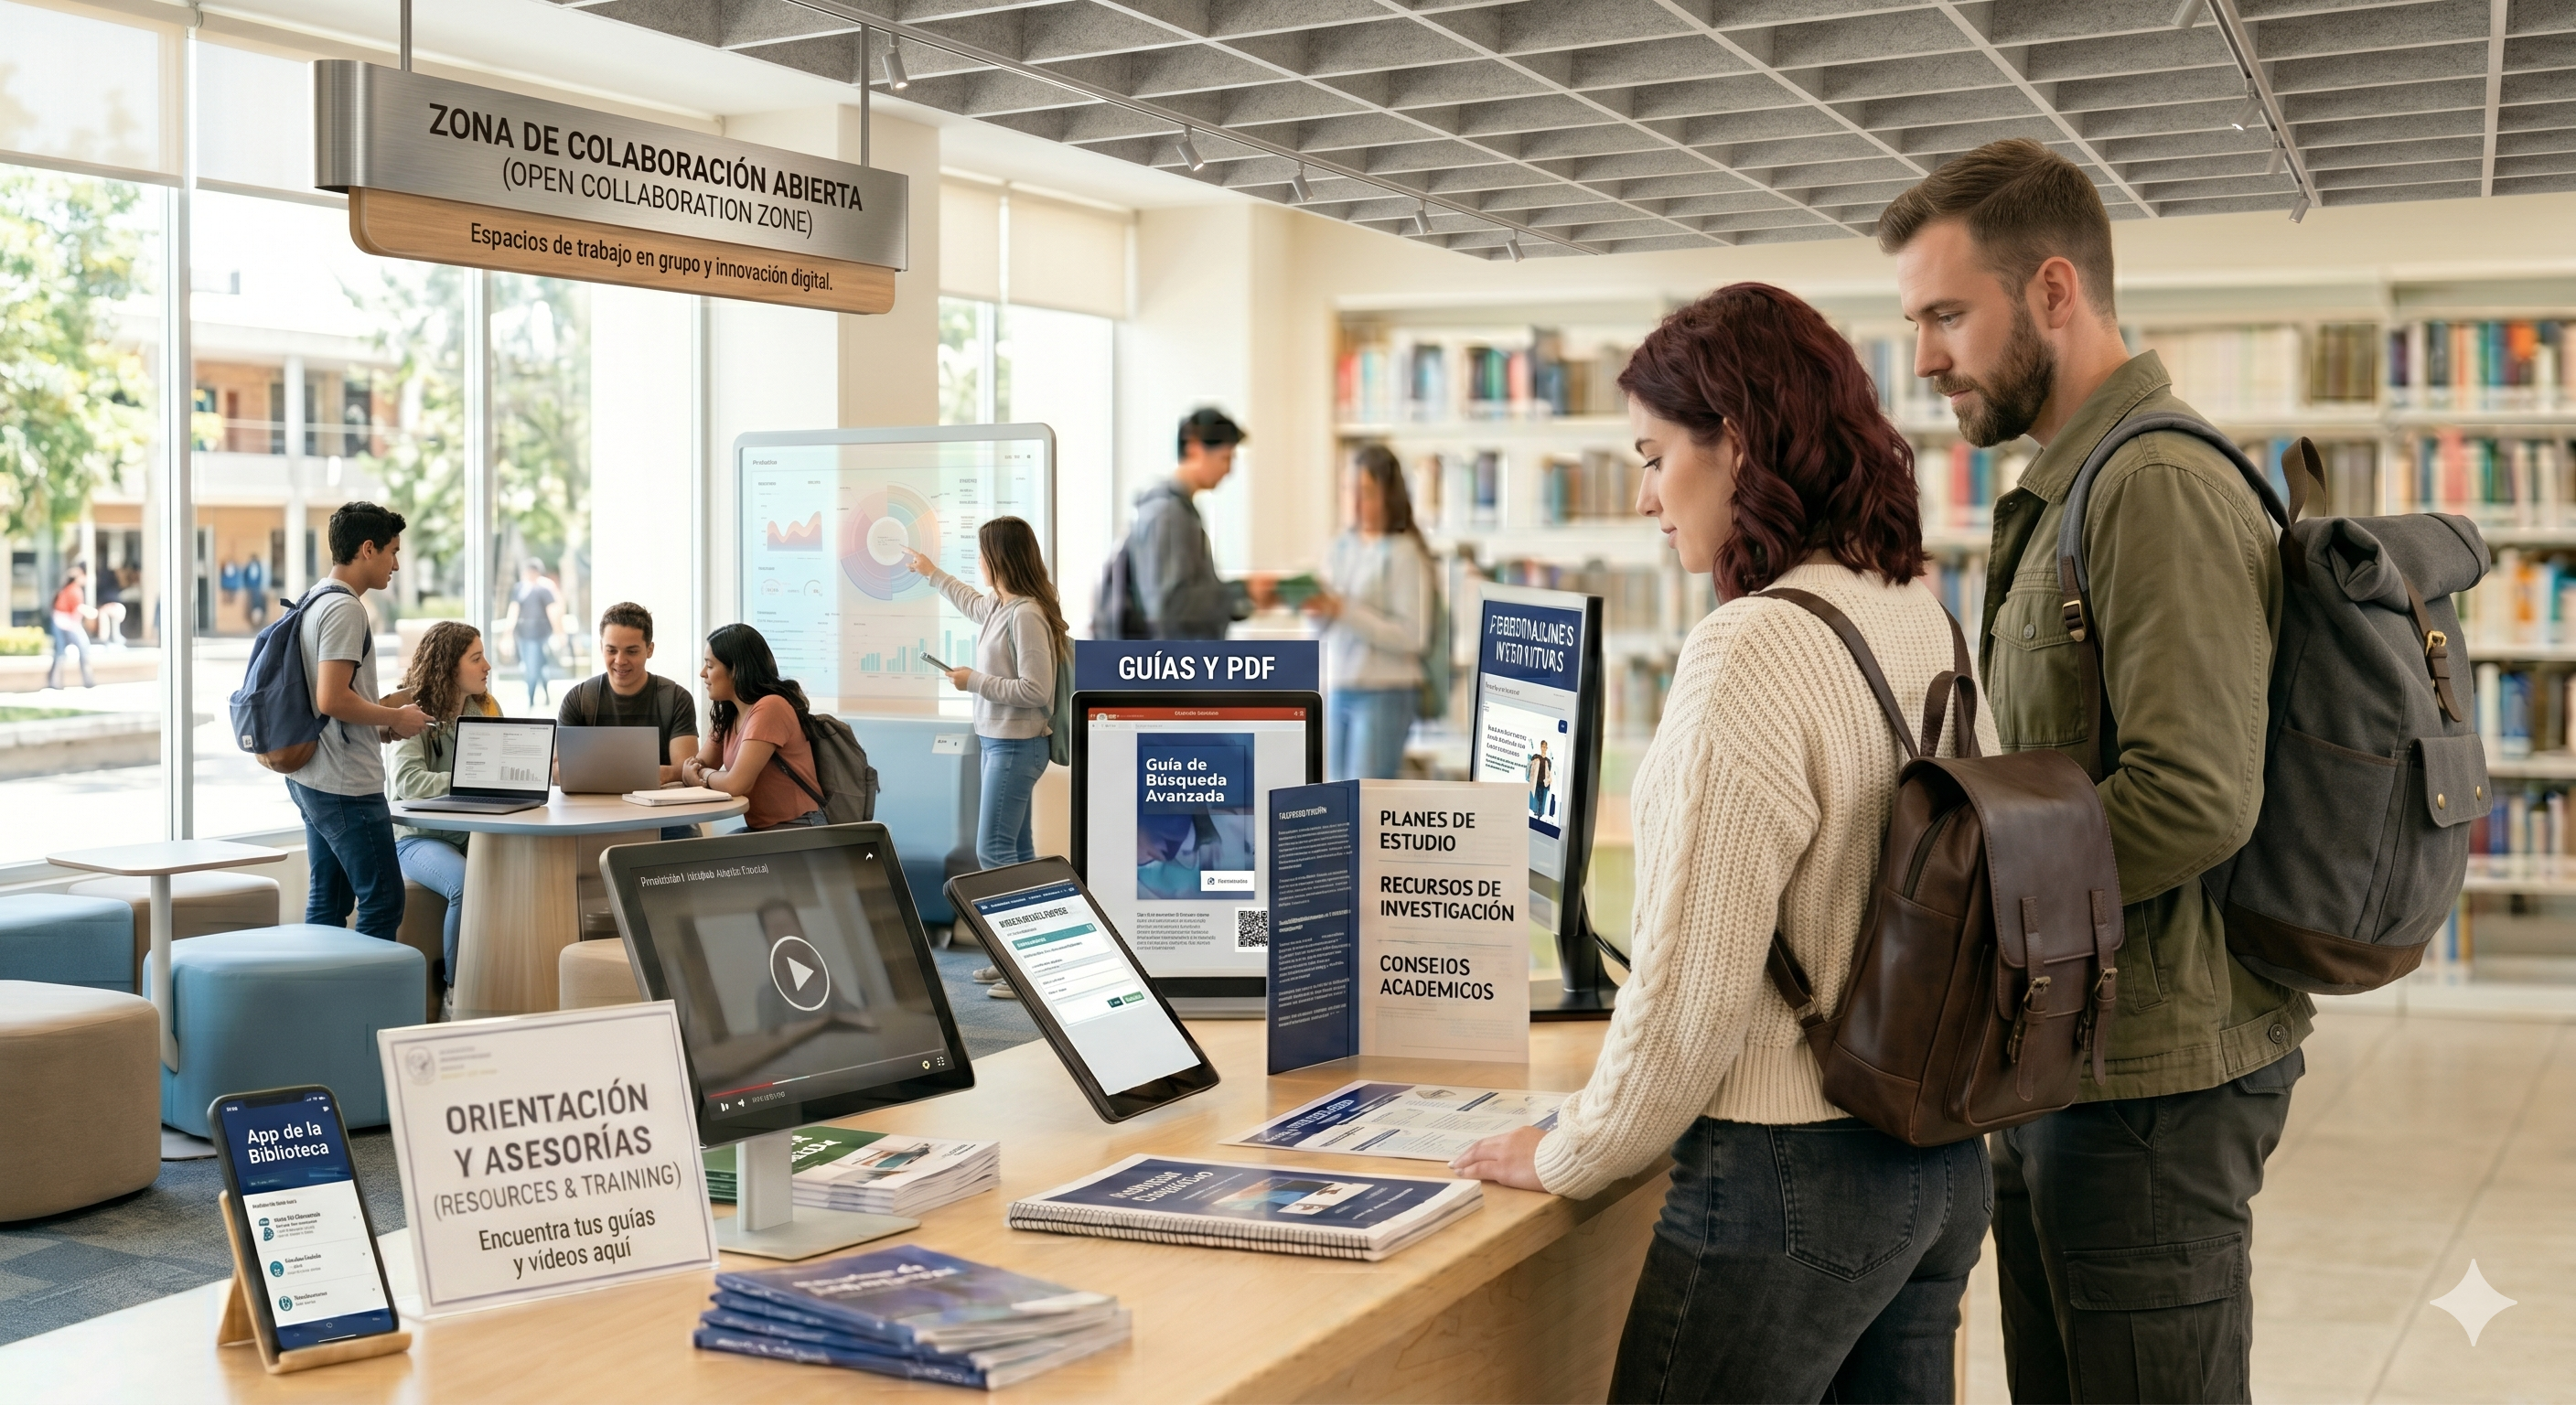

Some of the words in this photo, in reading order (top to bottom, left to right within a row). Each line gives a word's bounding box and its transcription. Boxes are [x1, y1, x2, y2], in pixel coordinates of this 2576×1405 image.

[429, 103, 513, 147] ZONA
[523, 122, 559, 156] DE
[568, 131, 766, 194] COLABORACIÓN
[773, 173, 863, 211] ABIERTA
[503, 157, 574, 196] (OPEN
[581, 174, 751, 223] COLLABORATION
[757, 204, 813, 239] ZONE)
[471, 223, 548, 252] Espacios
[553, 234, 573, 255] de
[577, 238, 632, 267] trabajo
[637, 250, 654, 265] en
[659, 252, 700, 275] grupo
[704, 261, 712, 278] y
[716, 258, 787, 285] innovación
[791, 268, 832, 292] digital.
[1119, 651, 1196, 680] GUÍAS
[1203, 657, 1219, 680] Y
[1228, 657, 1275, 680] PDF
[1146, 758, 1182, 771] Guía
[1187, 758, 1207, 771] de
[1146, 773, 1227, 790] Búsqueda
[1146, 788, 1224, 802] Avanzada
[1380, 810, 1447, 828] PLANES
[1453, 812, 1475, 828] DE
[1380, 833, 1455, 852] ESTUDIO
[1381, 876, 1473, 896] RECURSOS
[1478, 881, 1501, 897] DE
[1381, 900, 1514, 921] INVESTIGACIÓN
[1380, 979, 1494, 1000] ACADEMICOS
[446, 1078, 649, 1135] ORIENTACIÓN
[248, 1129, 279, 1144] App
[284, 1123, 303, 1139] de
[306, 1121, 322, 1135] la
[248, 1142, 329, 1164] Biblioteca
[455, 1147, 472, 1178] Y
[486, 1123, 651, 1175] ASESORÍAS
[434, 1180, 557, 1221] (RESOURCES
[565, 1178, 577, 1198] &
[582, 1162, 682, 1196] TRAINING)
[479, 1220, 570, 1250] Encuentra
[574, 1217, 603, 1237] tus
[608, 1207, 655, 1236] guías
[513, 1257, 523, 1279] y
[529, 1247, 587, 1271] vídeos
[594, 1237, 631, 1264] aquí
